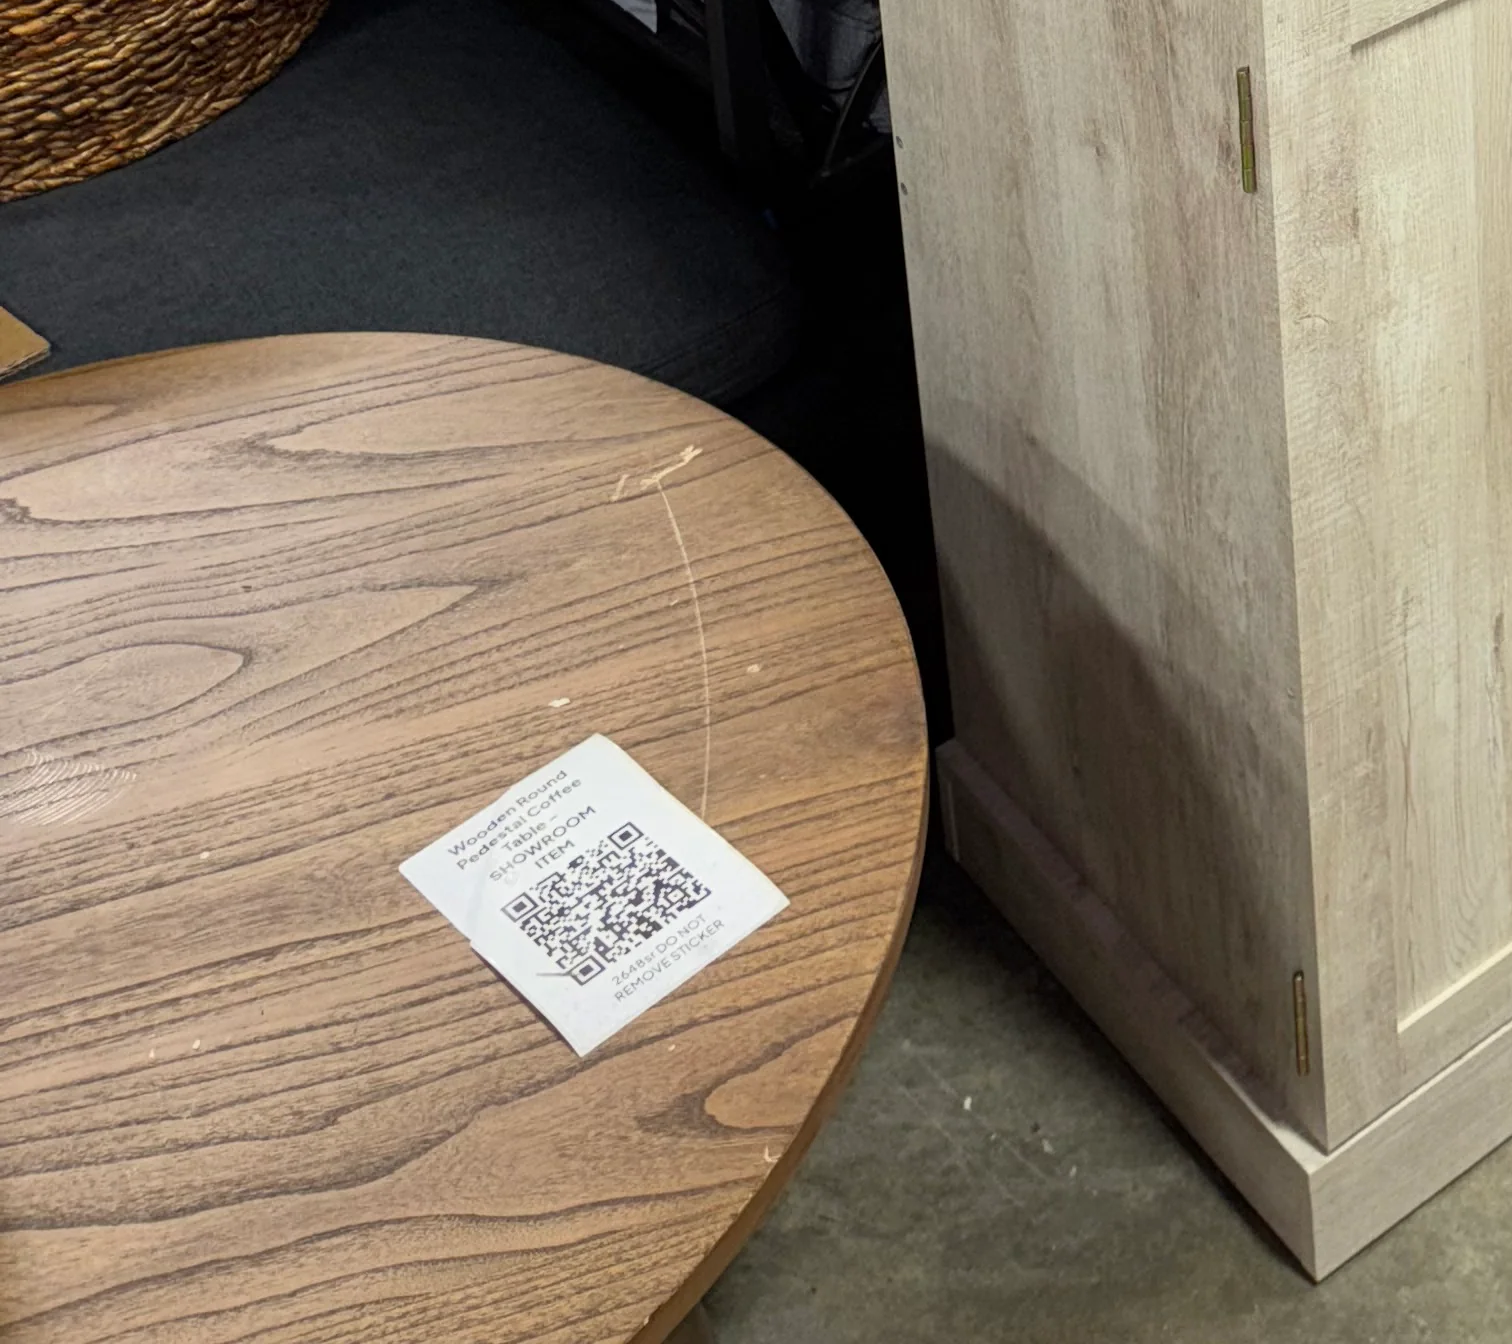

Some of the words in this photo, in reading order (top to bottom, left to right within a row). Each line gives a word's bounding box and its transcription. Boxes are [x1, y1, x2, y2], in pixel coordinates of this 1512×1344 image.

[447, 806, 517, 857] Wooden
[516, 770, 568, 808] Round
[456, 815, 528, 871] Pedestal
[527, 778, 582, 818] Coffee
[489, 805, 597, 882] SHOWROOM
[501, 821, 547, 852] Table
[534, 839, 576, 869] ITEM
[611, 952, 658, 986] 2648sr
[655, 935, 678, 954] DO
[677, 913, 707, 938] NOT
[614, 956, 672, 1003] REMOVE
[670, 919, 725, 962] STICKER
